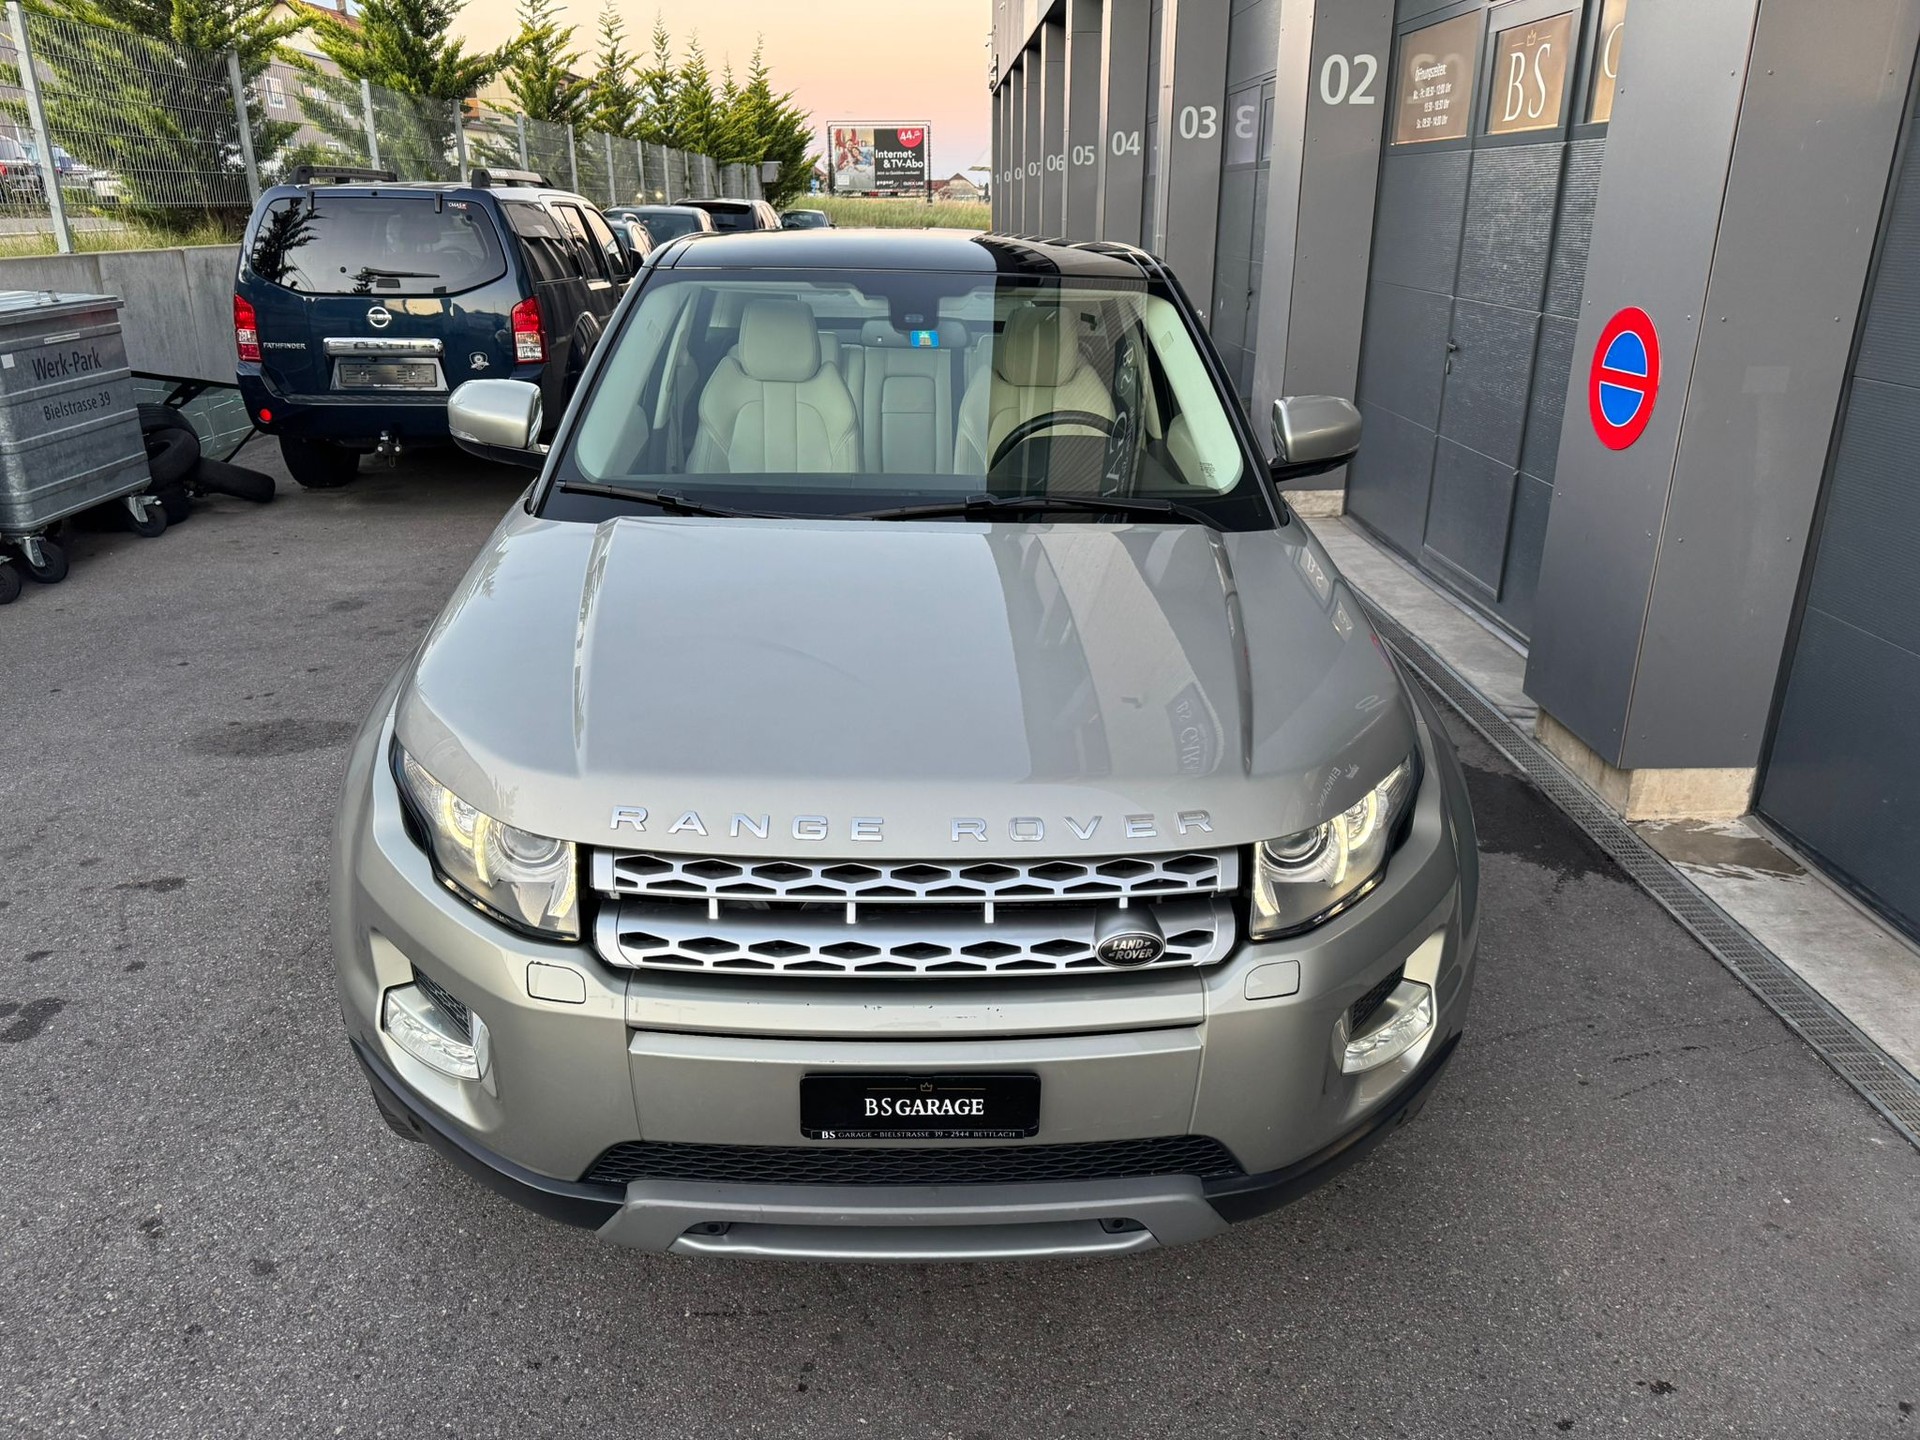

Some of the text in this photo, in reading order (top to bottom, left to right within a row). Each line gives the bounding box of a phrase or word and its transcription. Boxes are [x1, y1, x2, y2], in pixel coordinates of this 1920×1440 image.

[1320, 54, 1378, 105] 02
[1503, 43, 1551, 122] BS
[1179, 106, 1217, 139] 03
[875, 149, 916, 159] Internet-
[1112, 131, 1140, 155] 04
[1046, 154, 1064, 171] 06
[1072, 146, 1095, 166] 05
[263, 342, 306, 350] PATHFINDER
[31, 346, 102, 381] Werk-Park
[43, 391, 111, 421] Bielstrasse 39
[610, 805, 1214, 842] RANGE ROVER
[1112, 939, 1144, 951] LAND
[1115, 948, 1154, 960] ROVER
[821, 1130, 836, 1139] BS
